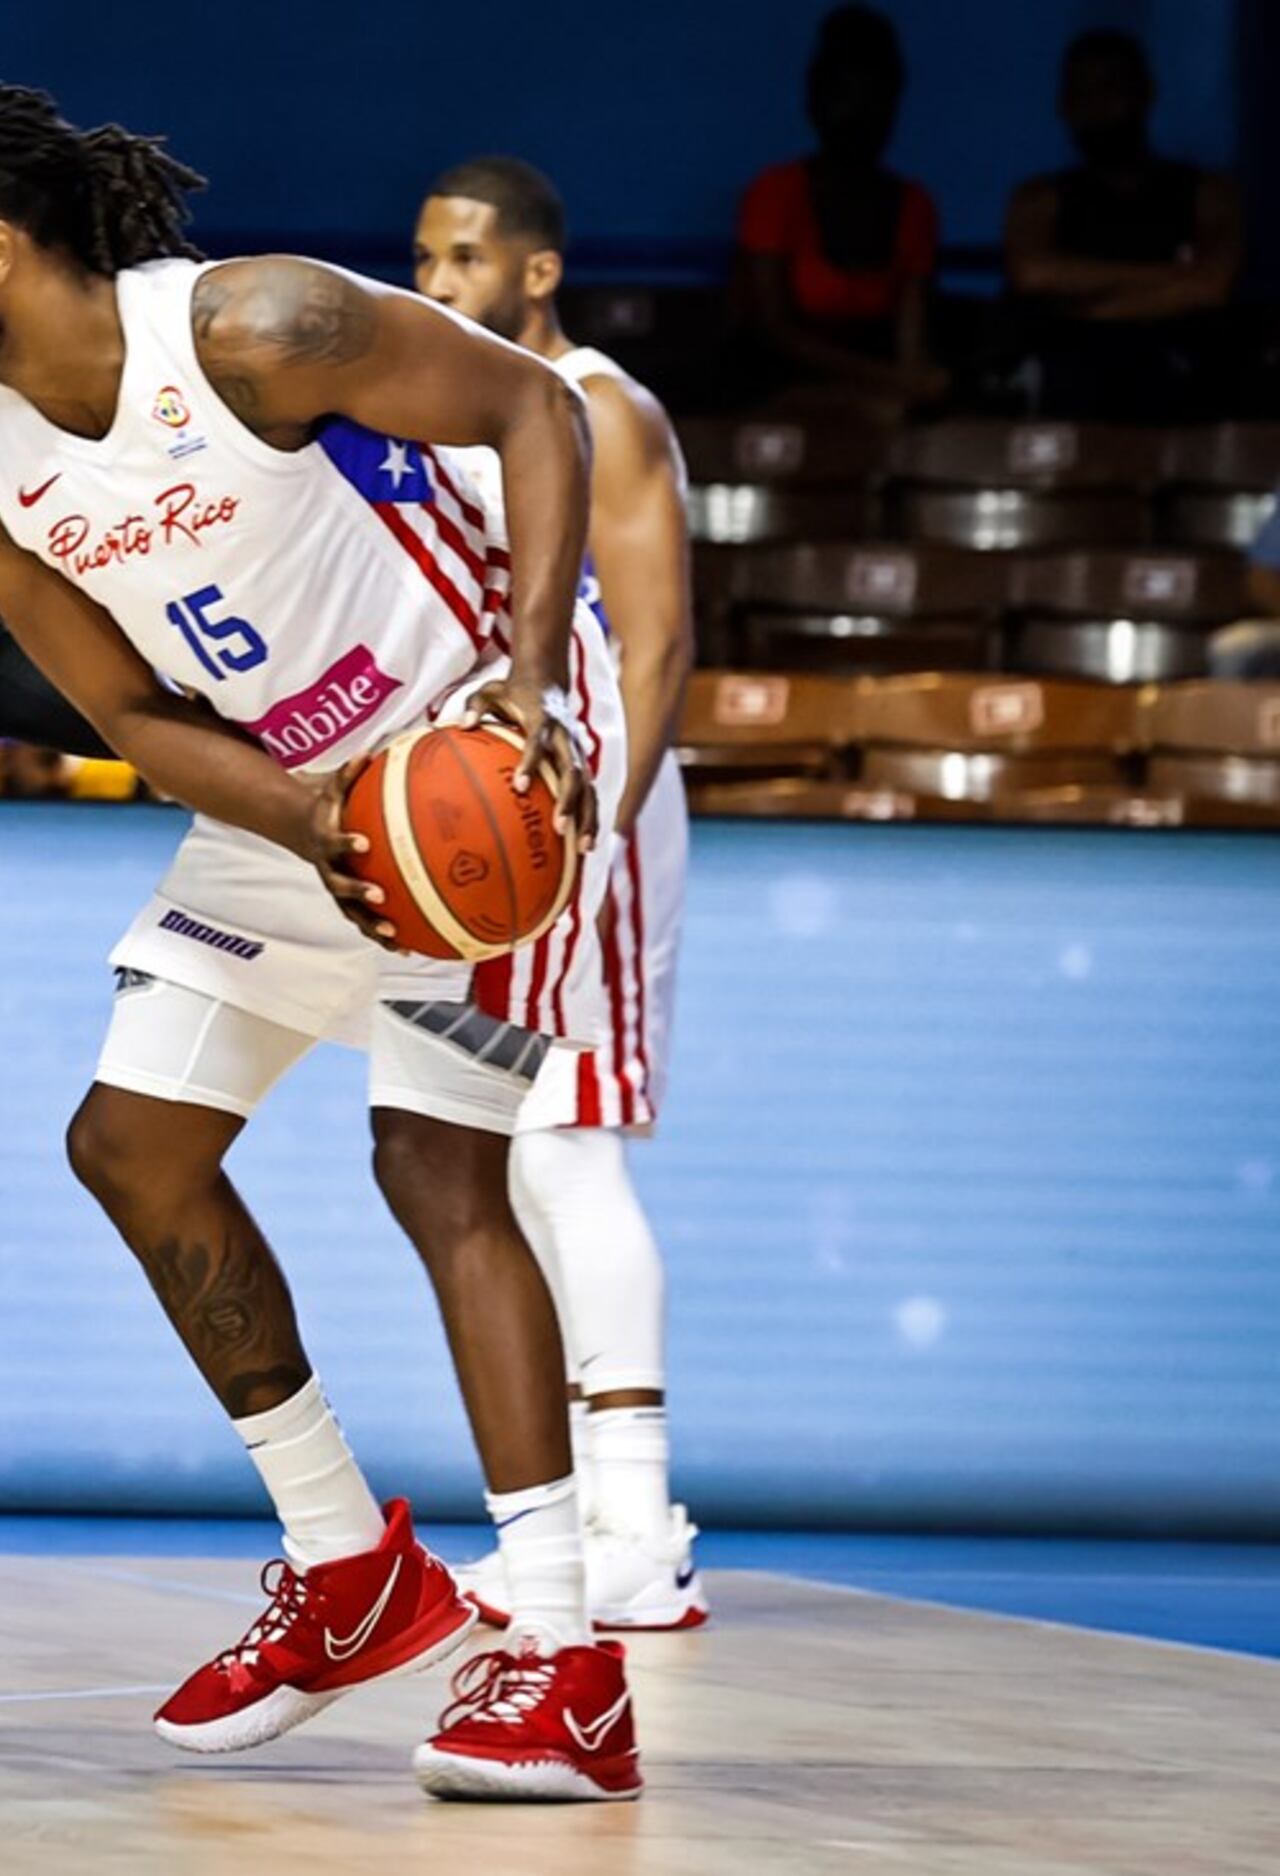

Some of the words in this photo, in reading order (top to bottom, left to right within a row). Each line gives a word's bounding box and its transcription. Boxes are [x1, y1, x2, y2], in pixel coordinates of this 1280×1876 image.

[47, 514, 153, 576] Puerto
[154, 483, 241, 548] Rico
[166, 582, 268, 681] 15
